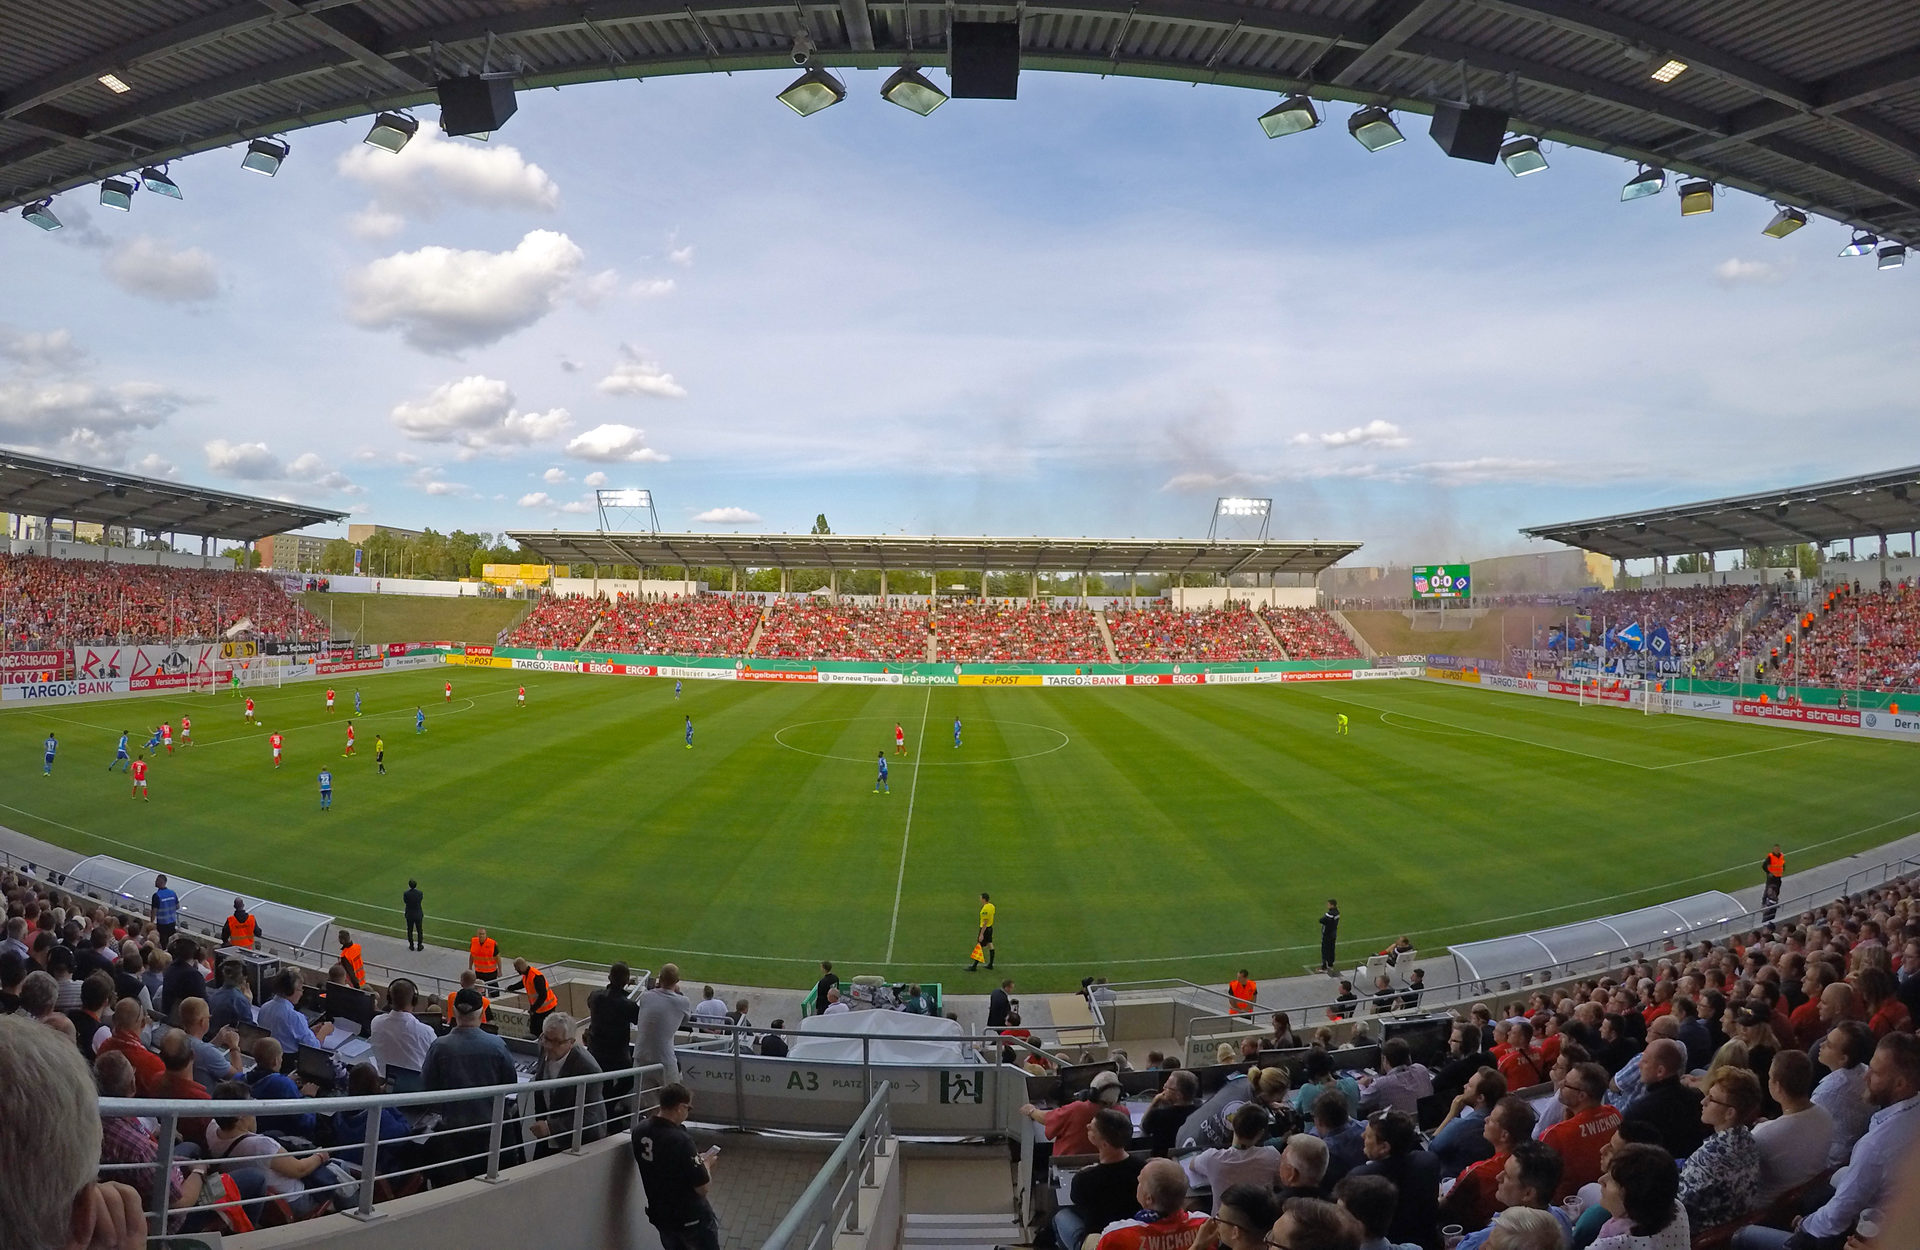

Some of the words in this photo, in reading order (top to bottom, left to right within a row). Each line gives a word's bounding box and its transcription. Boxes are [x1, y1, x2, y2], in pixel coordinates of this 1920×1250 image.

[589, 663, 614, 674] ERGO
[625, 665, 651, 675] ERGO
[744, 671, 784, 681] engelbert
[785, 673, 818, 681] strauss
[832, 674, 844, 682] Der
[909, 675, 957, 684] DFB-POKAL
[1133, 674, 1159, 684] ERGO
[1172, 674, 1198, 684] ERGO
[131, 678, 151, 688] ERGO
[1743, 703, 1803, 719] engelbert
[1806, 710, 1860, 725] strauss
[1894, 718, 1912, 729] Der
[705, 1070, 735, 1081] PLATZ
[744, 1073, 772, 1084] 01-20
[786, 1069, 820, 1091] A3
[832, 1079, 863, 1089] PLATZ
[640, 1136, 654, 1162] 3
